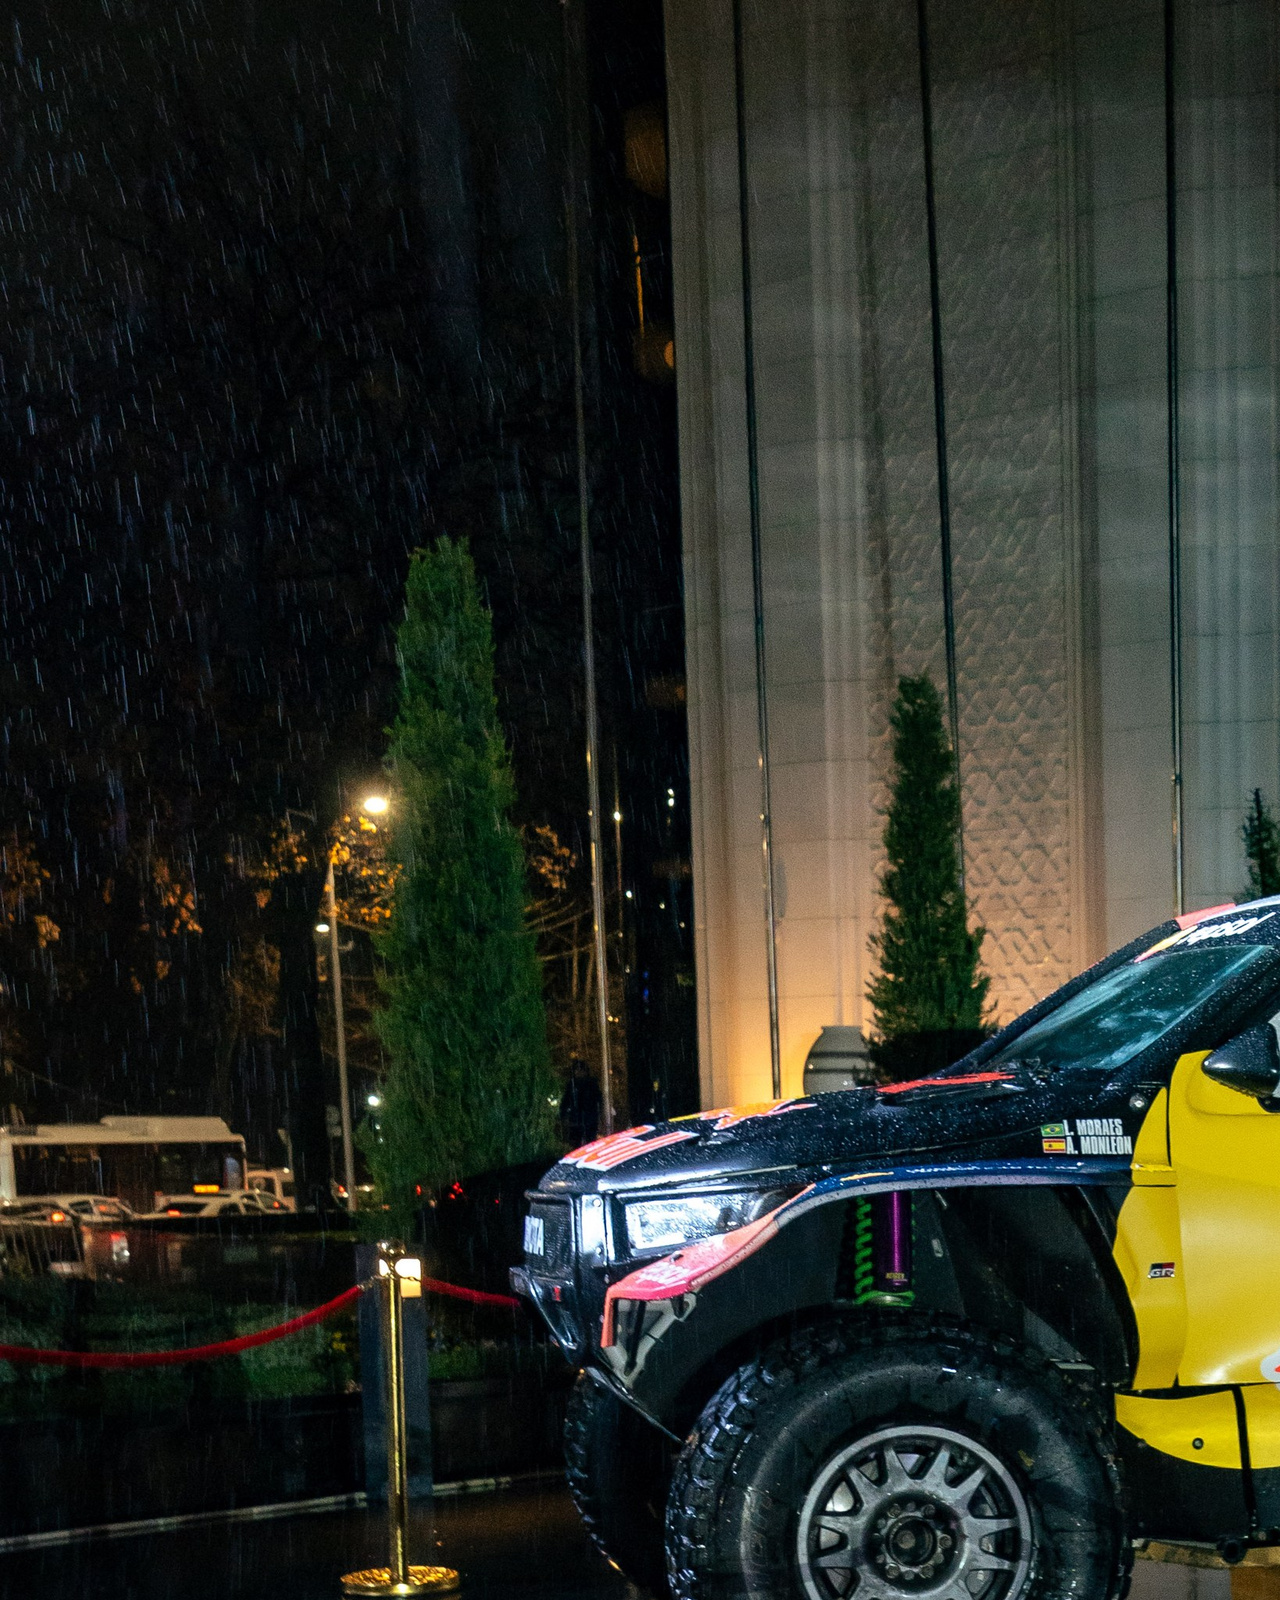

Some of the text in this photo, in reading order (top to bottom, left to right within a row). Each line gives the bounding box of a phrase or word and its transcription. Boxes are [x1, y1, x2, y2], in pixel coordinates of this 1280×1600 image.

[1063, 1119, 1123, 1136] L. MORAES
[1065, 1136, 1133, 1155] A. MONLEON
